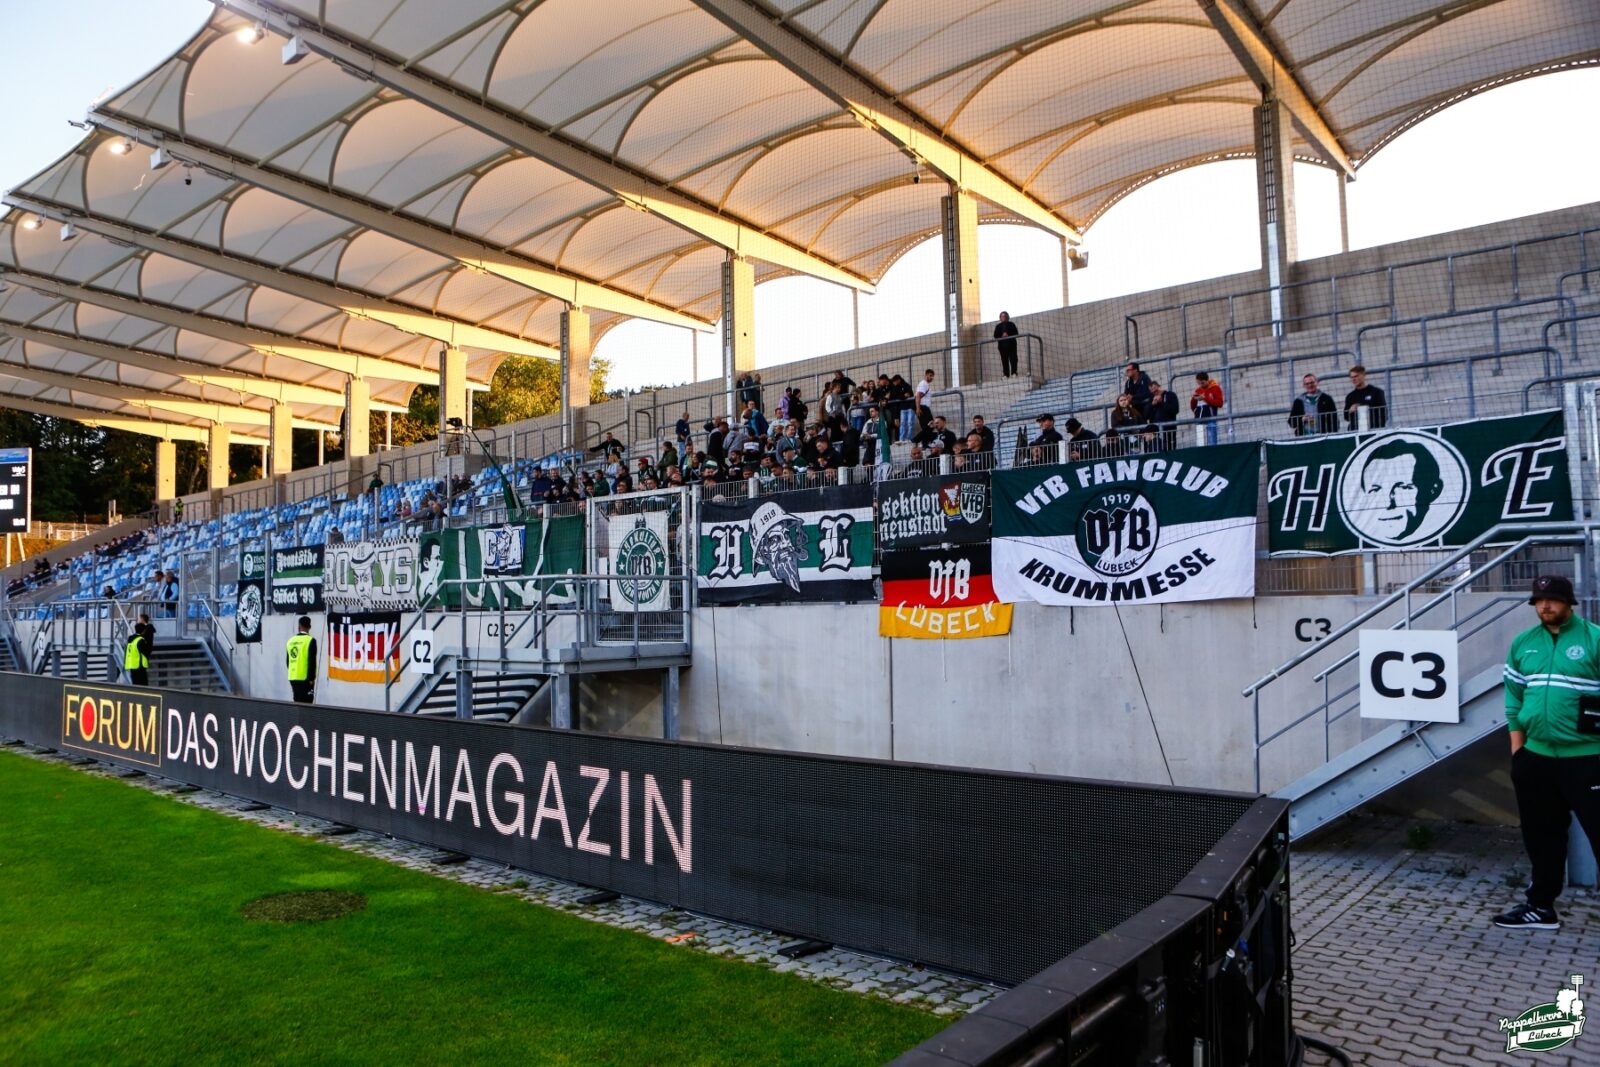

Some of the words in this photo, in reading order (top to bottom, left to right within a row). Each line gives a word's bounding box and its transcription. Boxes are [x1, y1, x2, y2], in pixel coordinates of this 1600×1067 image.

[961, 493, 984, 513] VfB
[1015, 474, 1070, 516] VfB
[1075, 458, 1229, 499] FANCLUB
[1101, 493, 1131, 507] 1919
[1267, 463, 1336, 532] H
[880, 510, 947, 542] neustadt
[1083, 504, 1151, 558] VfB
[928, 558, 971, 605] VfB
[1018, 547, 1216, 602] KRUMMESSE
[487, 623, 499, 637] C2
[896, 600, 995, 634] LÜBECK
[1294, 617, 1333, 642] C3
[328, 616, 398, 671] LÜBECK
[412, 640, 432, 664] C2
[1370, 650, 1447, 700] C3
[65, 694, 158, 756] FORUM
[166, 708, 219, 770] DAS
[230, 717, 693, 874] WOCHENMAGAZIN
